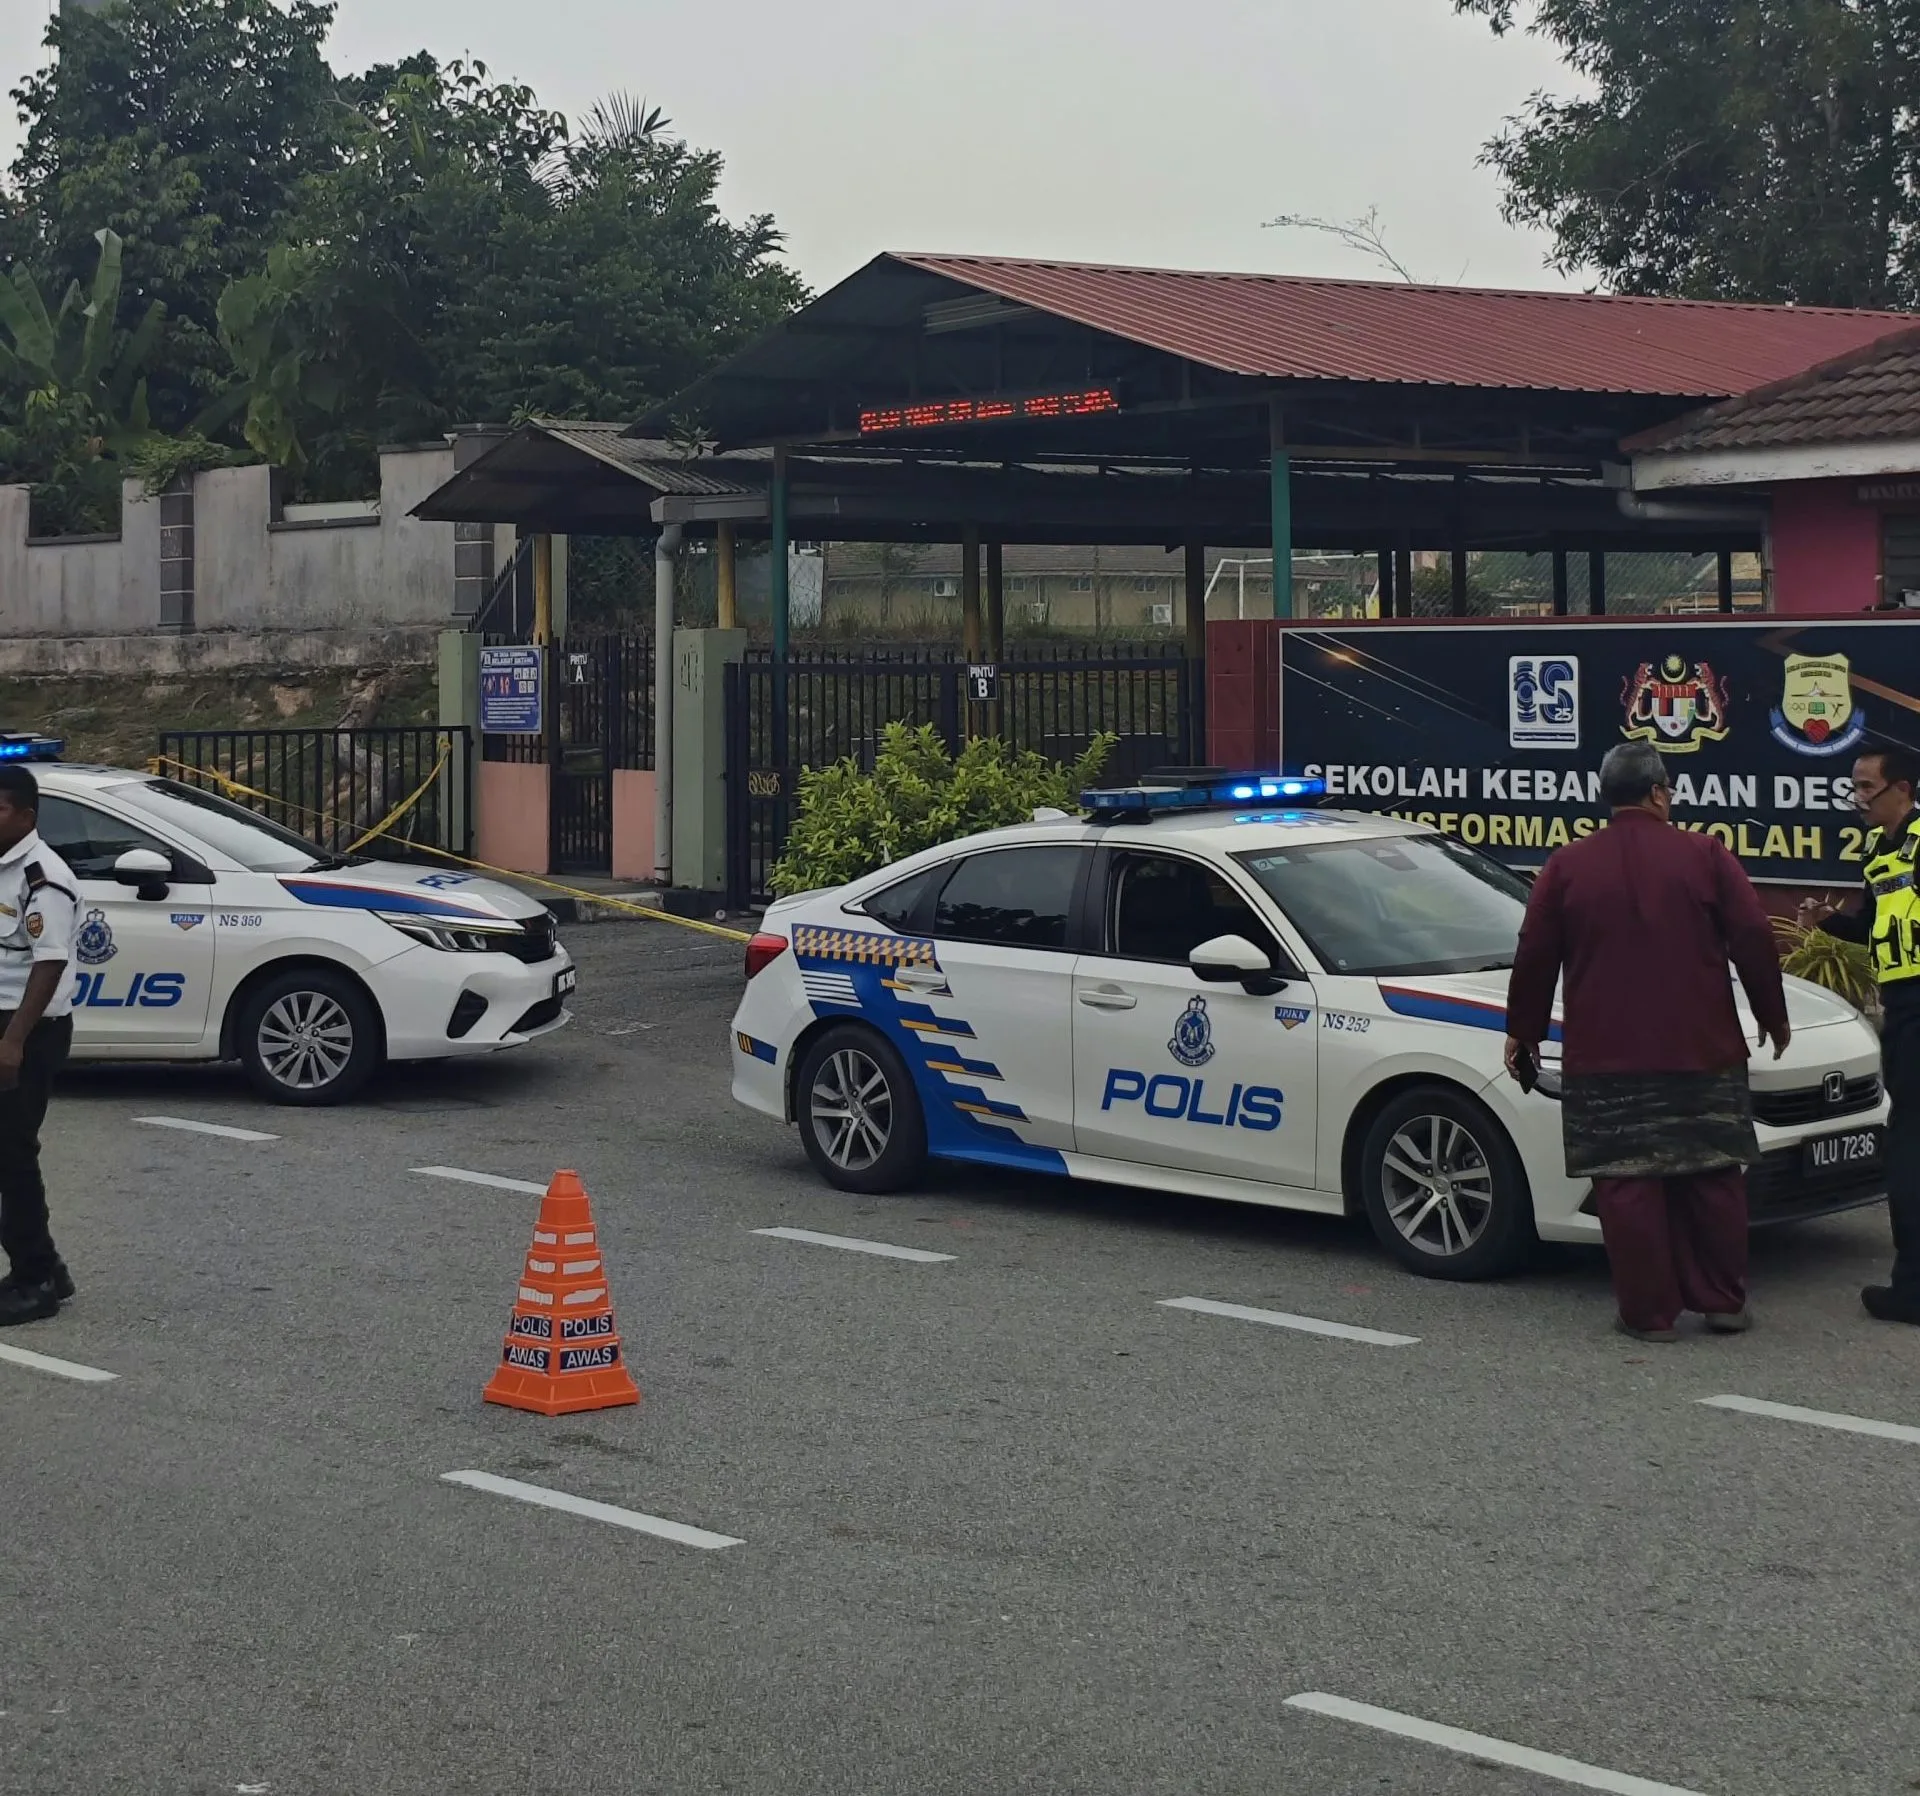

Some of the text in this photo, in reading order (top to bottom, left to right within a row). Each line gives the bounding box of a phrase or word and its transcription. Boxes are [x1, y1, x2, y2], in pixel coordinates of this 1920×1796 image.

[575, 665, 584, 682] A
[970, 666, 994, 678] PINTU
[978, 678, 988, 698] B
[1554, 707, 1573, 722] 25
[218, 914, 263, 927] NS 350
[71, 972, 186, 1008] LIS
[1277, 1006, 1306, 1021] JPJKK
[1322, 1012, 1372, 1034] NS 252
[1101, 1068, 1285, 1132] POLIS
[1812, 1131, 1876, 1166] VLU 7236
[513, 1315, 551, 1337] POLIS
[563, 1316, 611, 1337] POLIS
[508, 1347, 545, 1368] AWAS
[566, 1347, 612, 1369] AWAS
